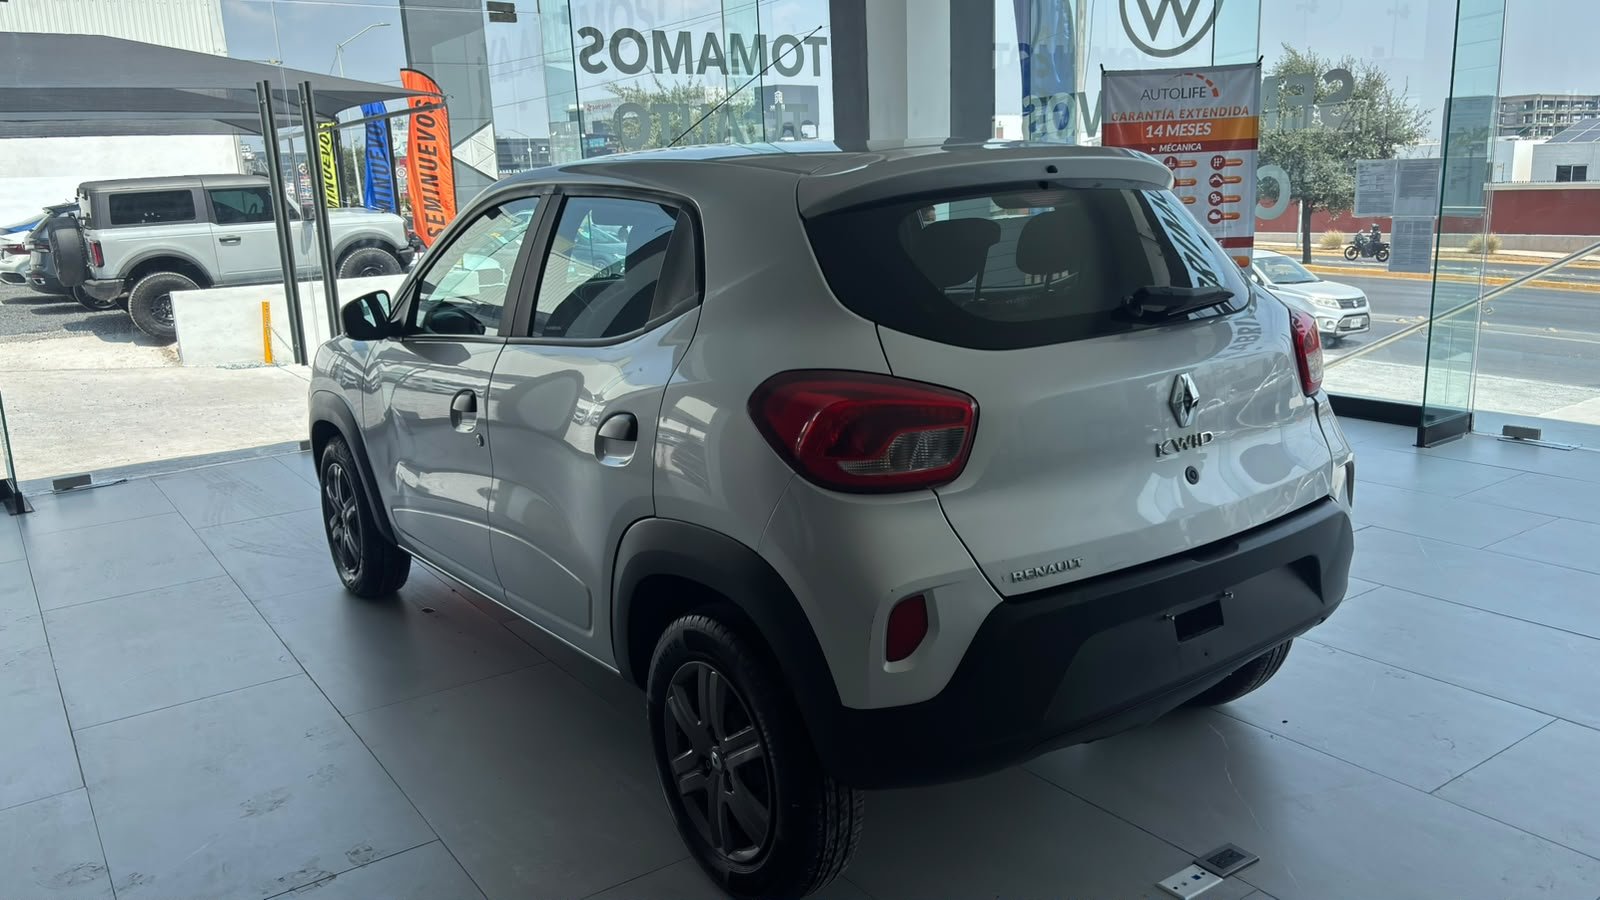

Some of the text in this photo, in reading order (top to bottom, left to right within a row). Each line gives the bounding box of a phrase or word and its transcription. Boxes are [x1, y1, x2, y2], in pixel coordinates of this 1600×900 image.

[1141, 86, 1207, 101] AUTOLIFE
[1111, 106, 1249, 122] GARANTÍA EXTENDIDA
[1146, 123, 1212, 138] 14 MESES
[1155, 431, 1214, 457] KWID
[1011, 558, 1083, 583] RENAULT
